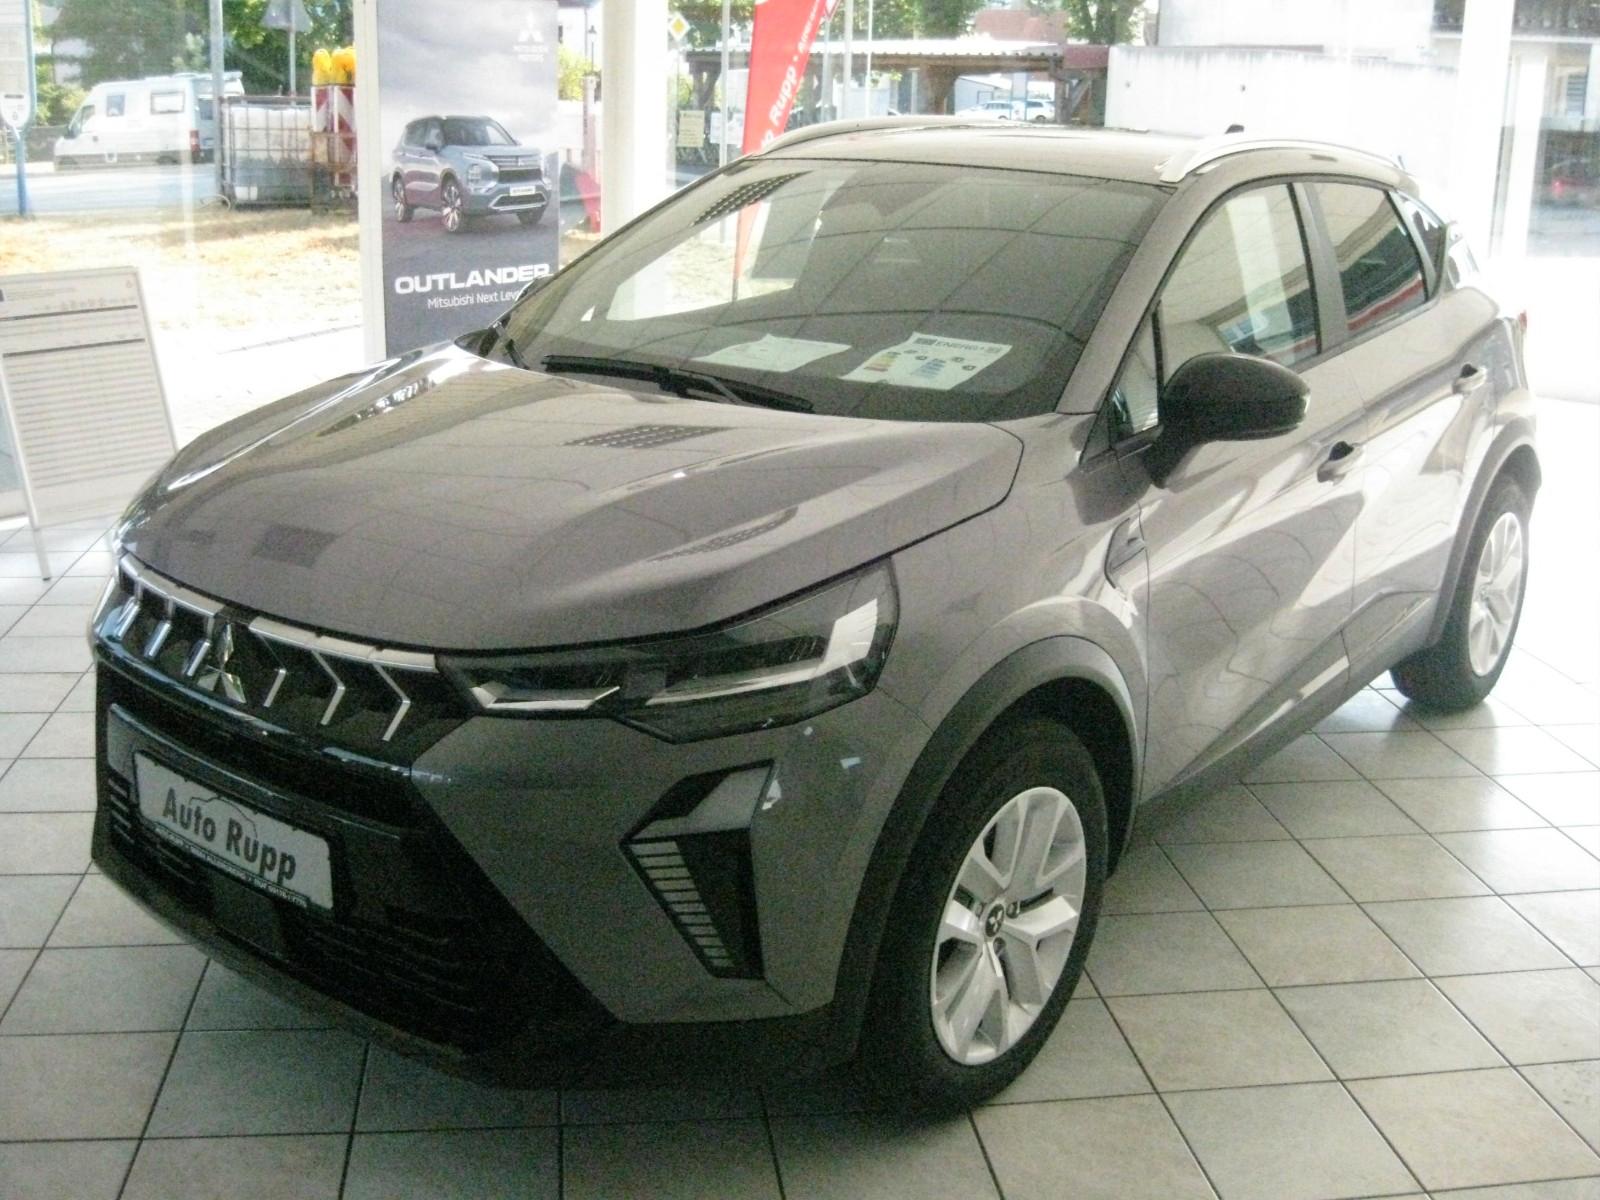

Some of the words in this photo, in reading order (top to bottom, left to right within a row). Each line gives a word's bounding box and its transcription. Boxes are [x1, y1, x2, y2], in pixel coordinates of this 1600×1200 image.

[769, 65, 797, 127] Rupp
[394, 263, 550, 295] OUTLANDER
[427, 293, 475, 309] Mitsubishi
[477, 290, 499, 304] Next
[500, 289, 520, 301] Lev
[162, 788, 217, 842] Auto
[225, 818, 297, 886] Rupp
